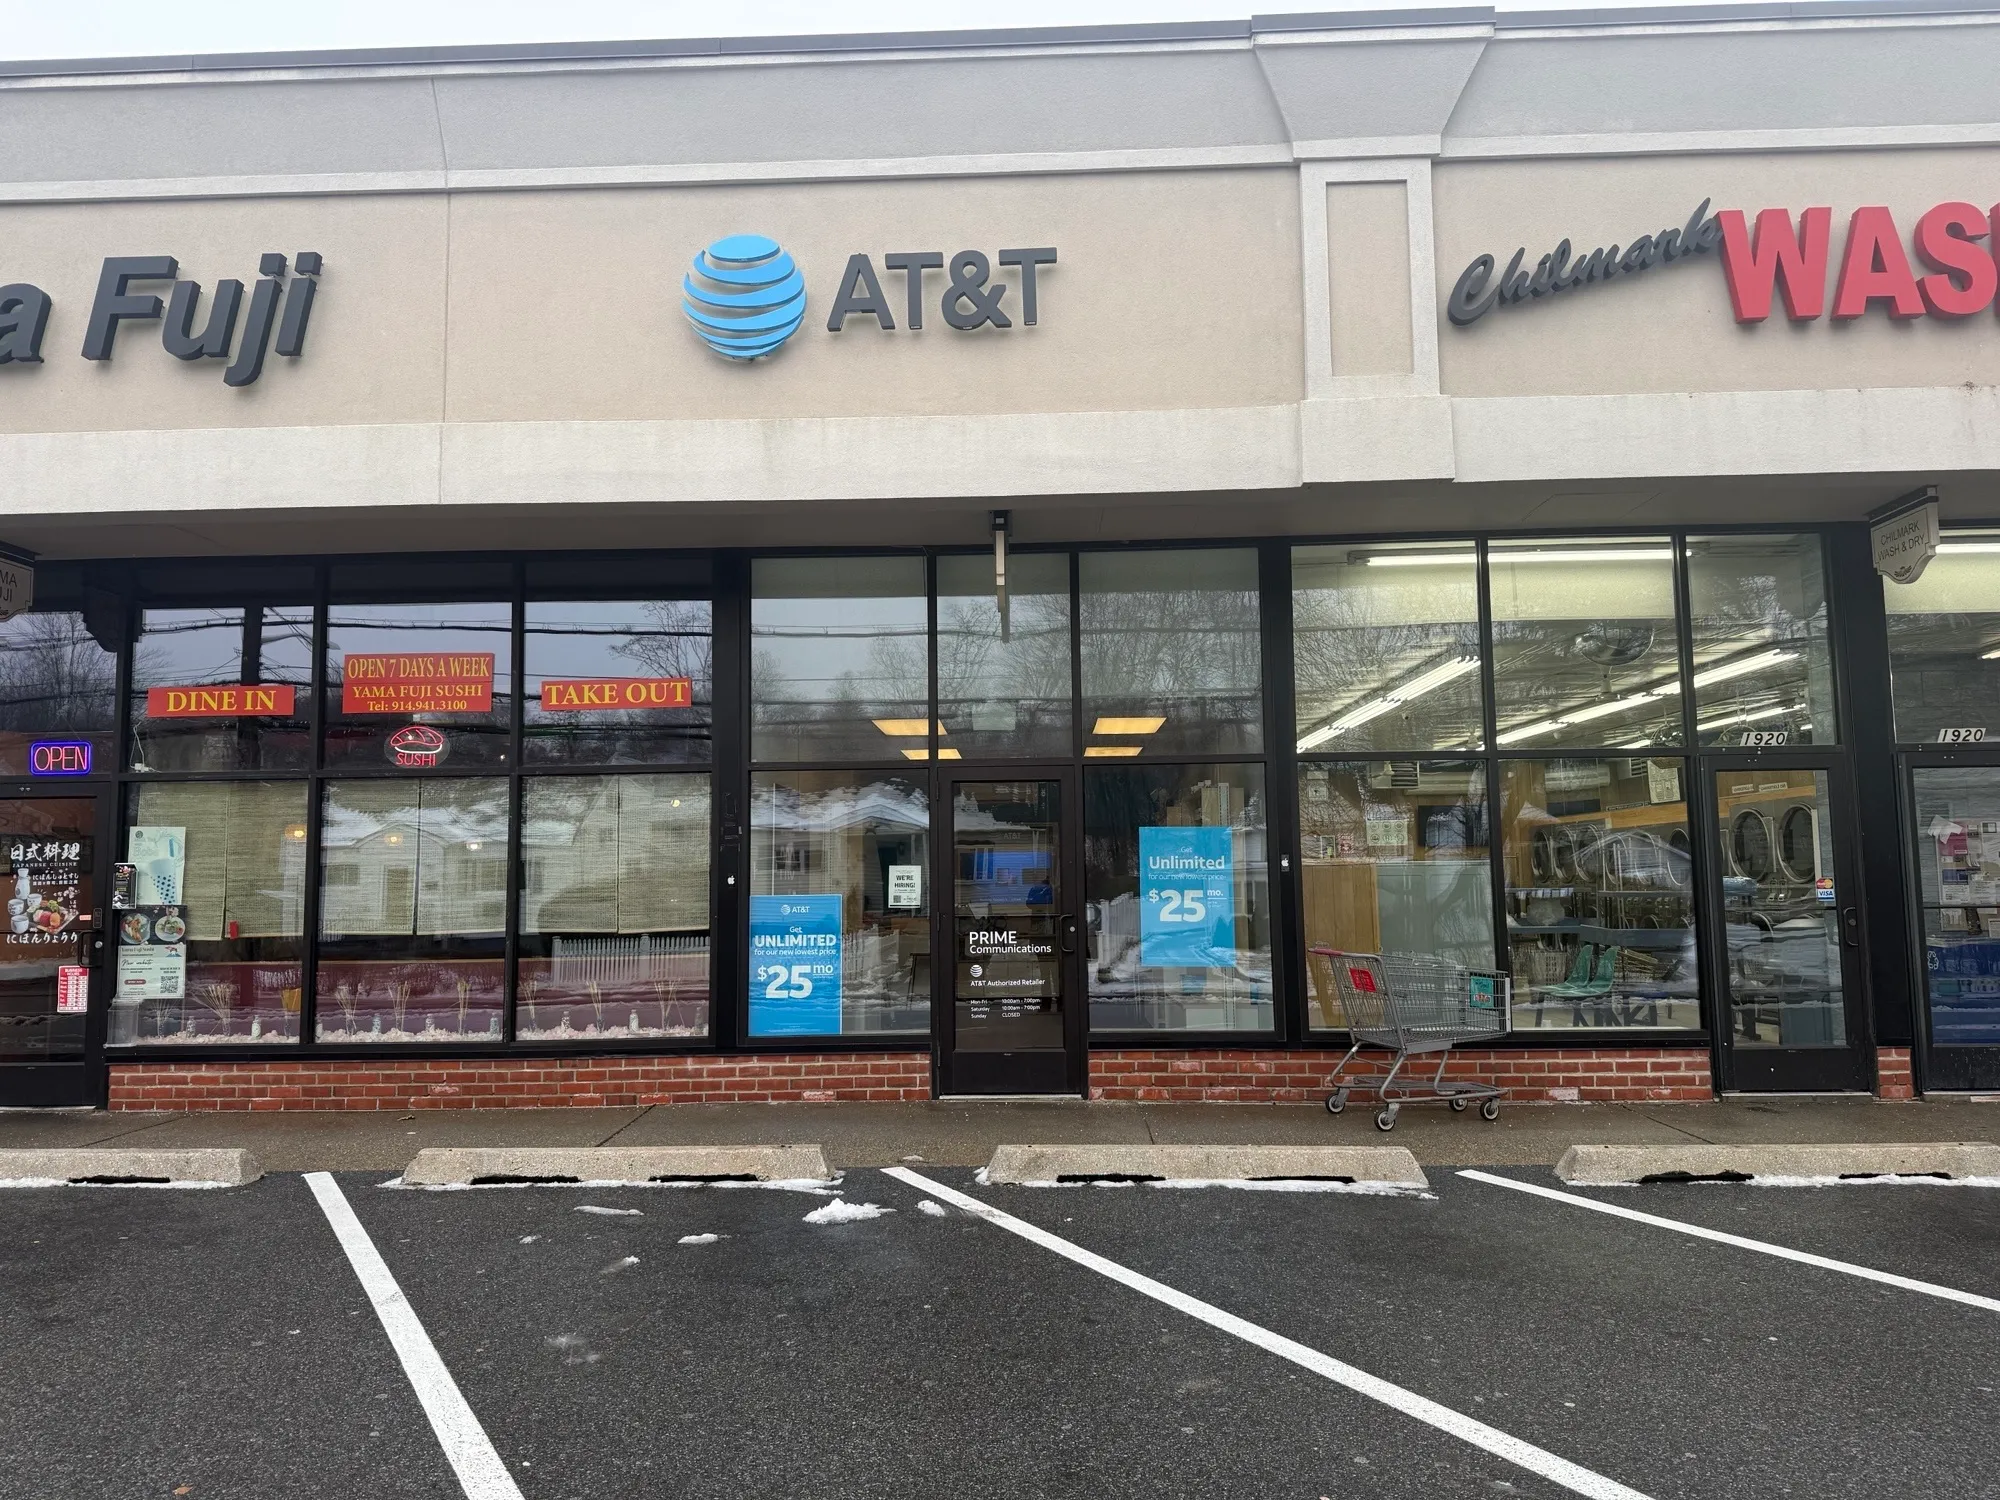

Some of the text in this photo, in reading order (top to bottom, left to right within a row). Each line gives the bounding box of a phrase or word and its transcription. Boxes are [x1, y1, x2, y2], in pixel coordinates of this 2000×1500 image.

[1448, 197, 2000, 326] Chilmark WAS
[827, 247, 1057, 332] AT&T
[81, 251, 324, 387] Fuji
[1880, 520, 1920, 546] CHILMARK
[1877, 534, 1925, 561] WASH & DRY
[348, 656, 490, 679] OPEN 7 DAYS A WEEK
[166, 690, 278, 712] DINE IN
[353, 685, 483, 699] YAMA FUJI SUSHI
[544, 680, 689, 706] TAKE OUT
[367, 700, 467, 711] Tel: 914.941.3100
[1744, 732, 1787, 746] 1920
[1941, 729, 1985, 743] 1920
[33, 745, 88, 772] OPEN
[395, 752, 437, 767] SUSHI
[10, 841, 81, 862] 日式料理
[1148, 855, 1225, 869] Unlimited
[792, 906, 811, 914] AT&T
[1148, 888, 1206, 922] $25
[754, 934, 837, 947] UNLIMITED
[969, 930, 1017, 945] PRIME
[754, 948, 765, 956] for
[969, 943, 1052, 954] Communications
[757, 965, 813, 999] $25
[987, 979, 1021, 987] Authorized
[1021, 978, 1045, 986] Retailer
